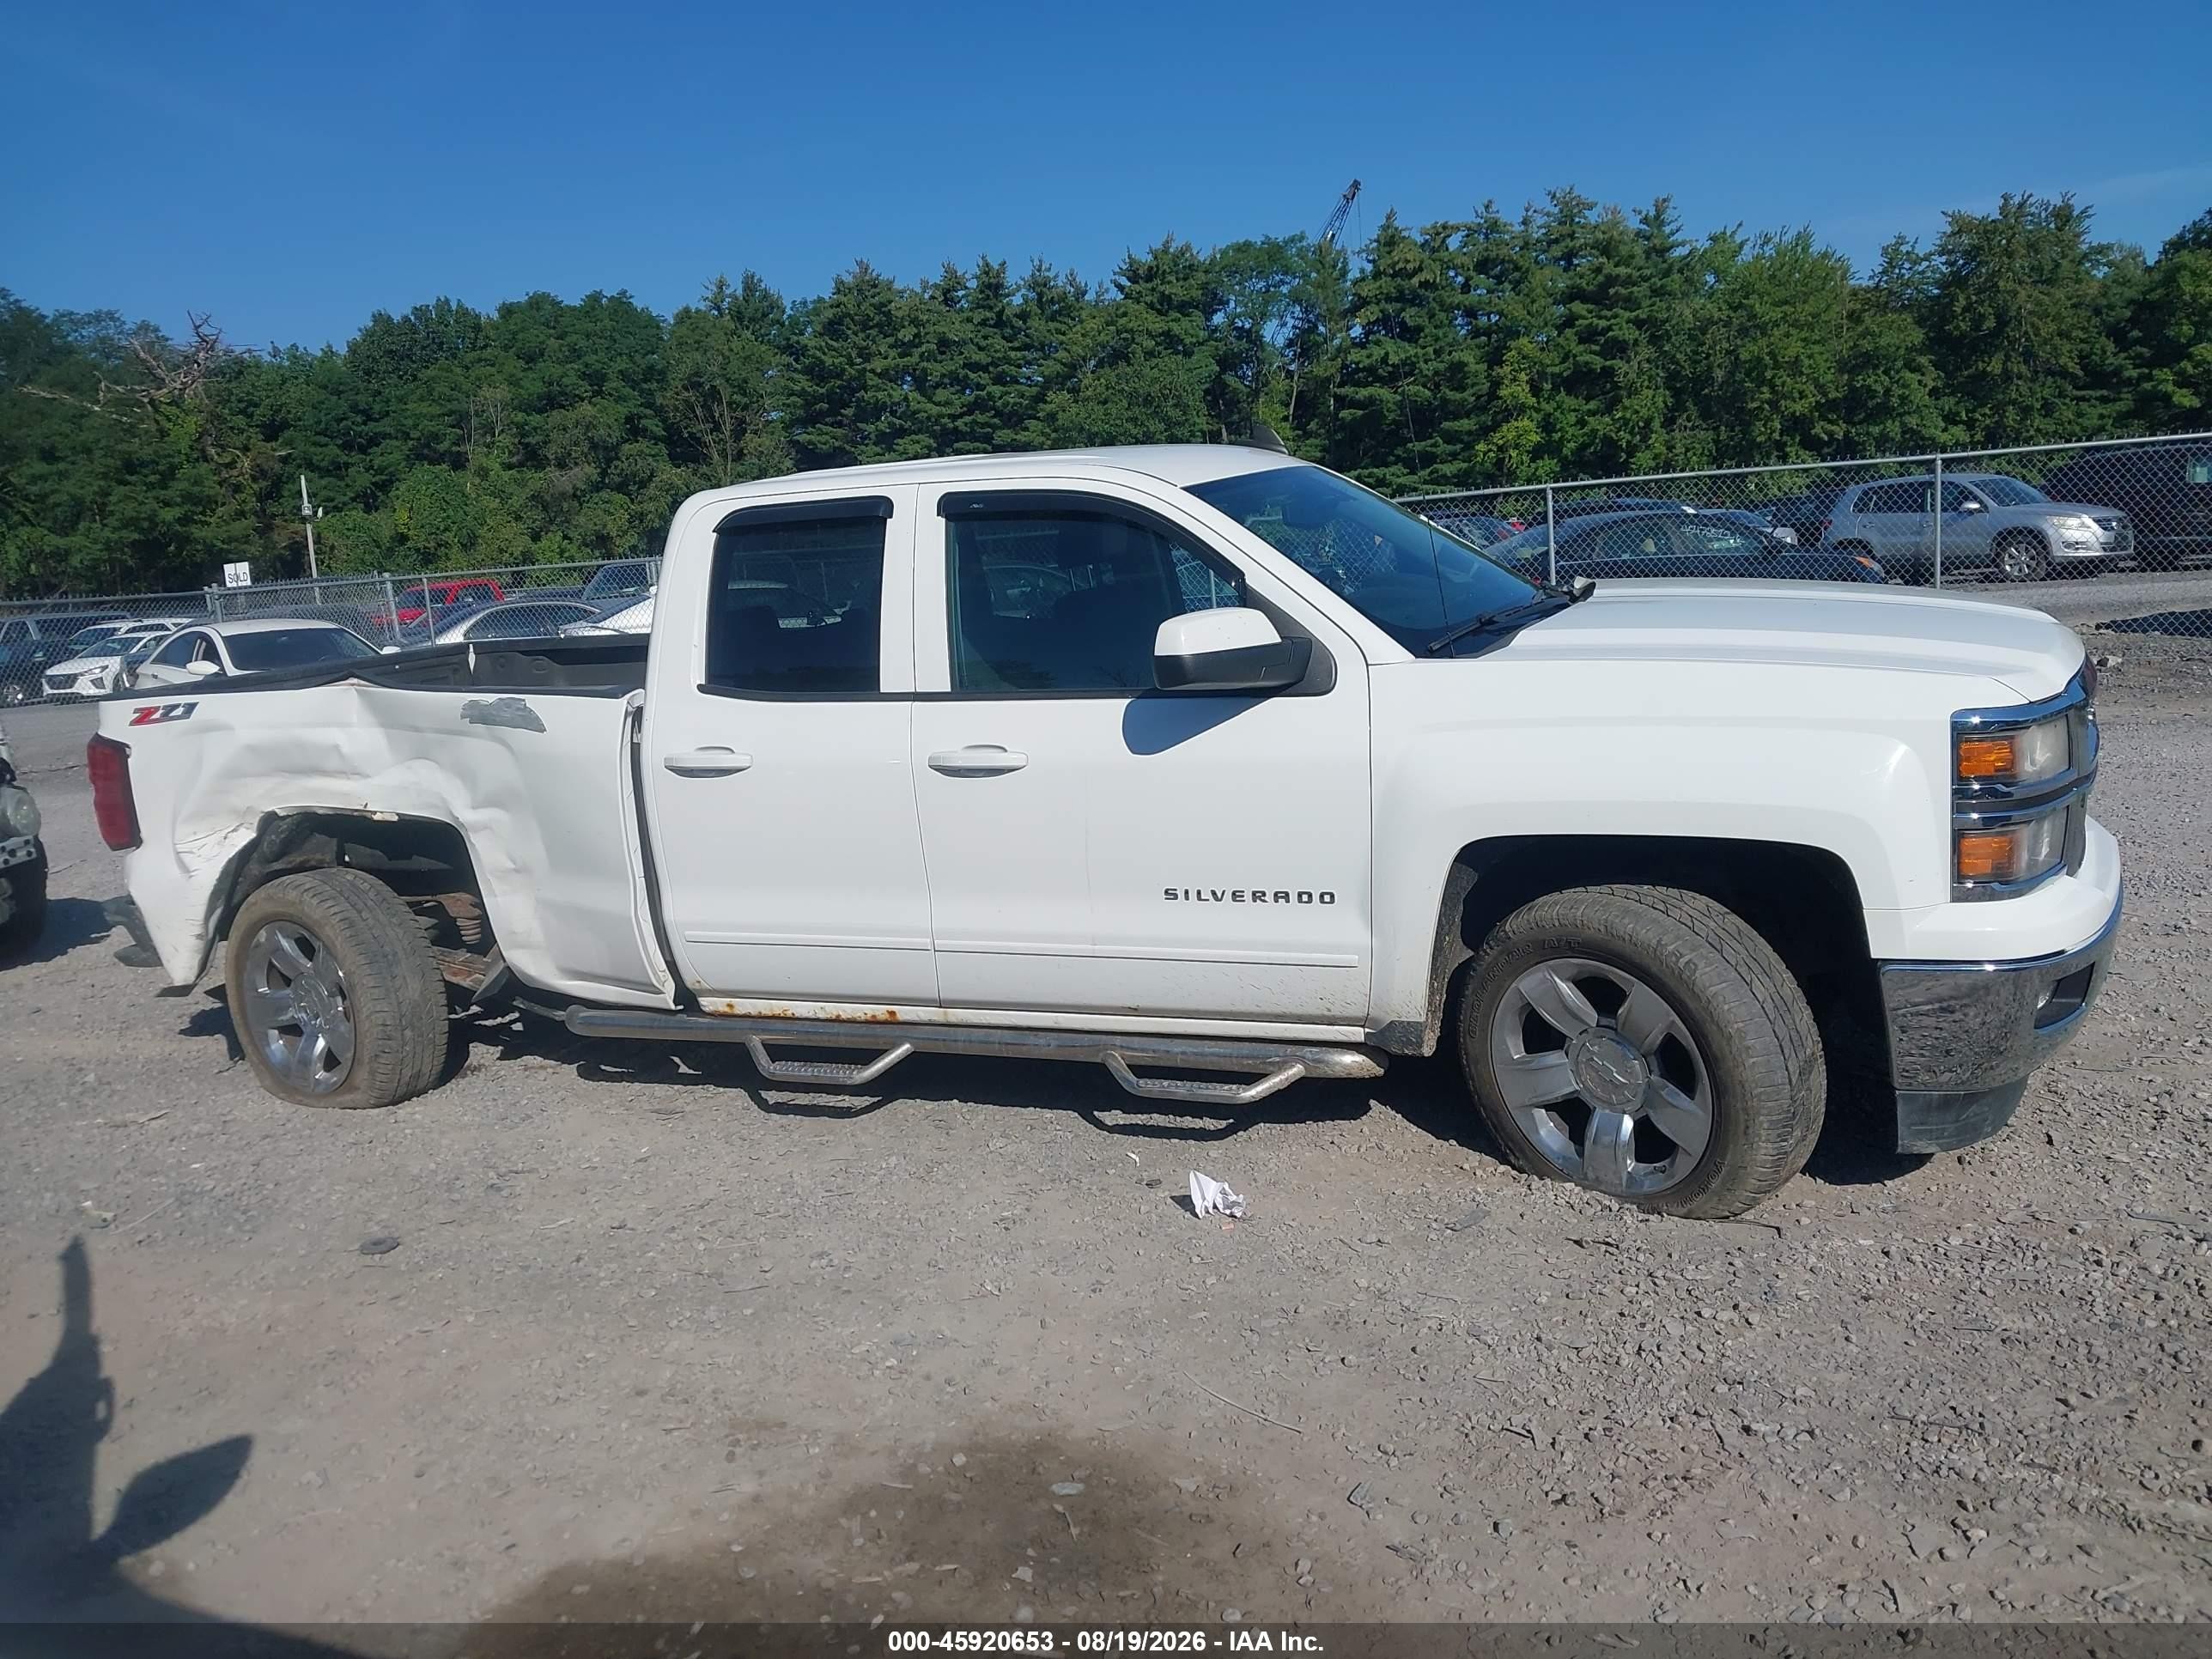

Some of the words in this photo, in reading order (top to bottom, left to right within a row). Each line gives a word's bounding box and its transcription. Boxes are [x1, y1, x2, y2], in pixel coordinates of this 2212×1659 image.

[228, 571, 248, 584] SOLD
[128, 701, 200, 726] Z71
[1164, 888, 1336, 905] SILVERADO
